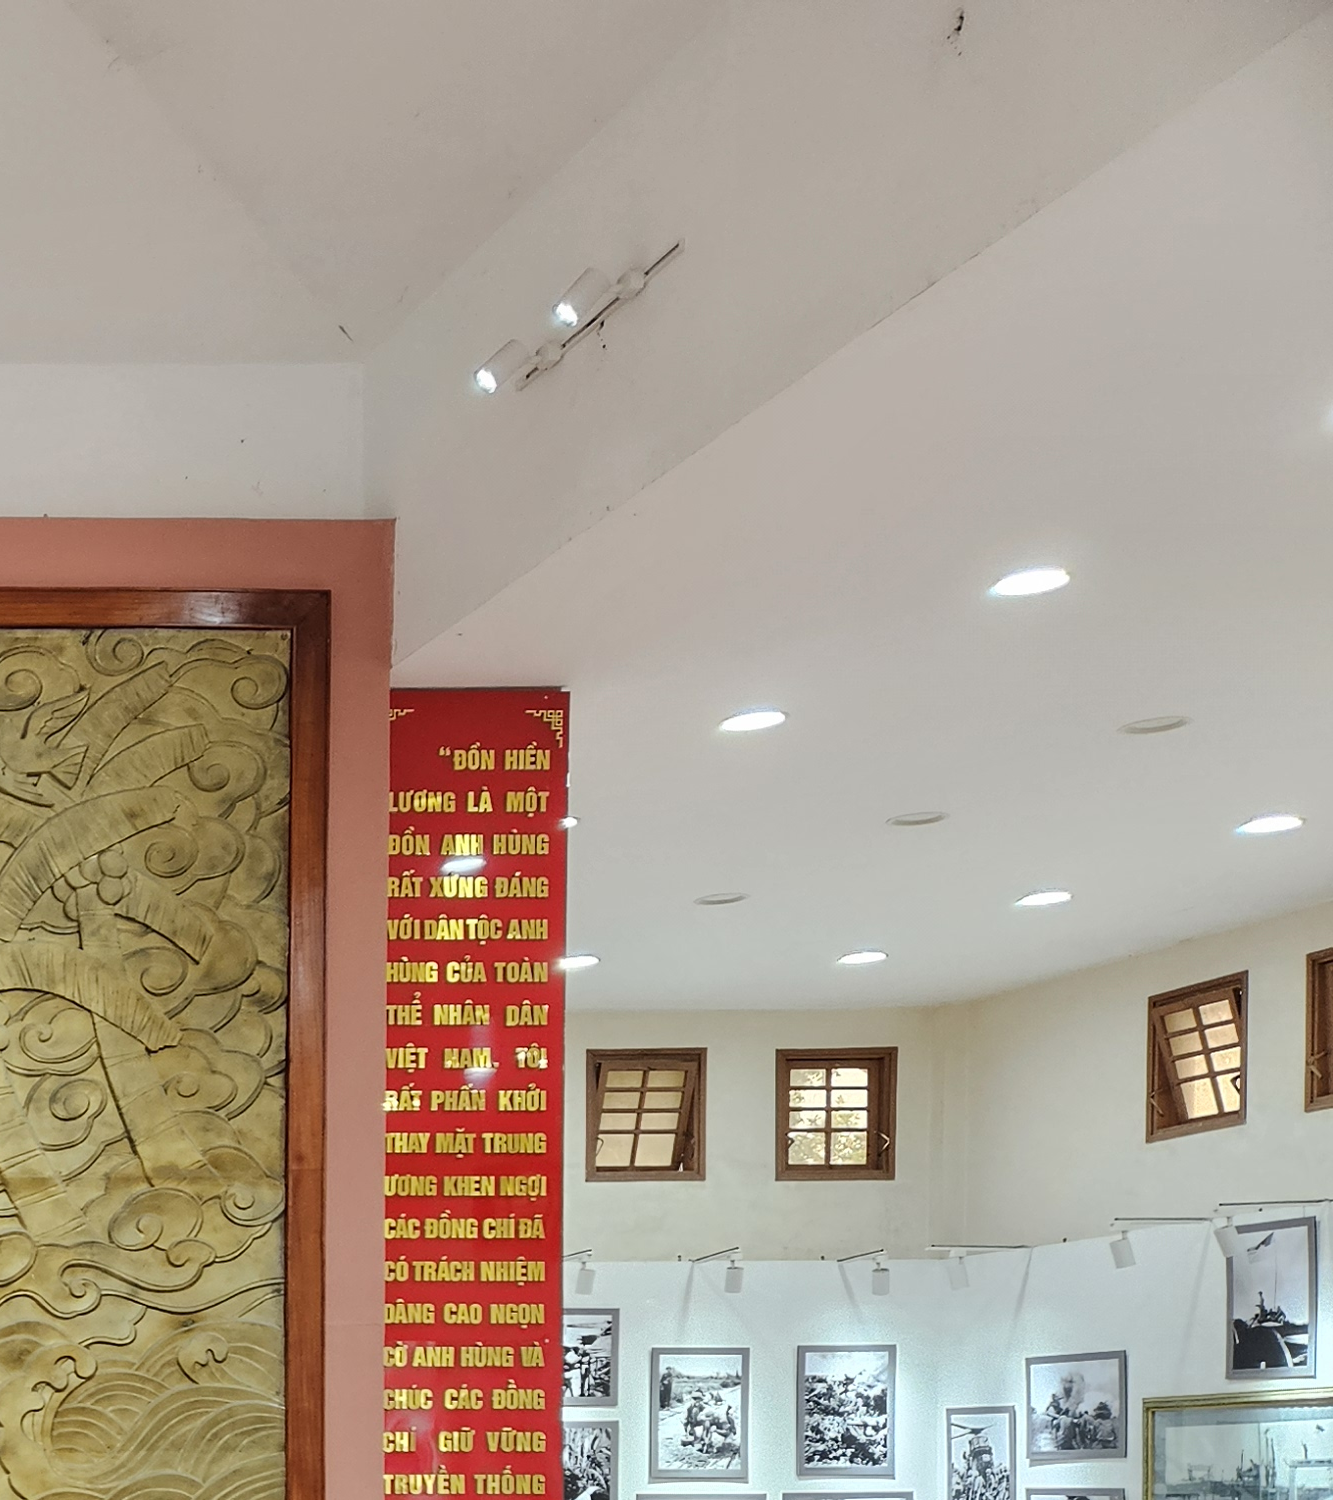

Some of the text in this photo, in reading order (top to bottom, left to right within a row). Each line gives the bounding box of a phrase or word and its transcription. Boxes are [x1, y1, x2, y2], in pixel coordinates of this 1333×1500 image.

[504, 743, 550, 770] HIỀN
[389, 787, 548, 816] LƯƠNG LÀ MỘT
[388, 826, 549, 857] ĐỒN ANH HÙNG
[386, 869, 548, 898] RẤT ĐÁNG
[424, 915, 464, 941] DÂN
[465, 915, 502, 945] TỘC
[506, 919, 548, 940] ANH
[385, 956, 549, 984] HÙNG CỦA TOÀN
[384, 992, 548, 1026] THỂ NHÂN DÂN
[383, 1043, 427, 1073] VIỆT
[430, 1084, 485, 1111] PHẤN
[498, 1083, 546, 1111] KHỞI
[383, 1129, 546, 1158] THAY MẶT TRUNG
[382, 1174, 546, 1201] ƯƠNG KHEN NGỢI
[383, 1210, 544, 1241] CÁC ĐỒNG CHÍ ĐÃ
[382, 1256, 545, 1285] CÓ TRÁCH NHIỆM
[443, 1303, 482, 1324] CAO
[489, 1304, 544, 1328] NGỌN
[381, 1342, 544, 1369] CỜ ANH HÙNG VÀ
[382, 1380, 545, 1411] CHÚC CÁC ĐỒNG
[436, 1427, 475, 1453] GIỮ
[486, 1427, 545, 1452] VỮNG
[382, 1466, 545, 1496] TRUYỀN THỐNG
